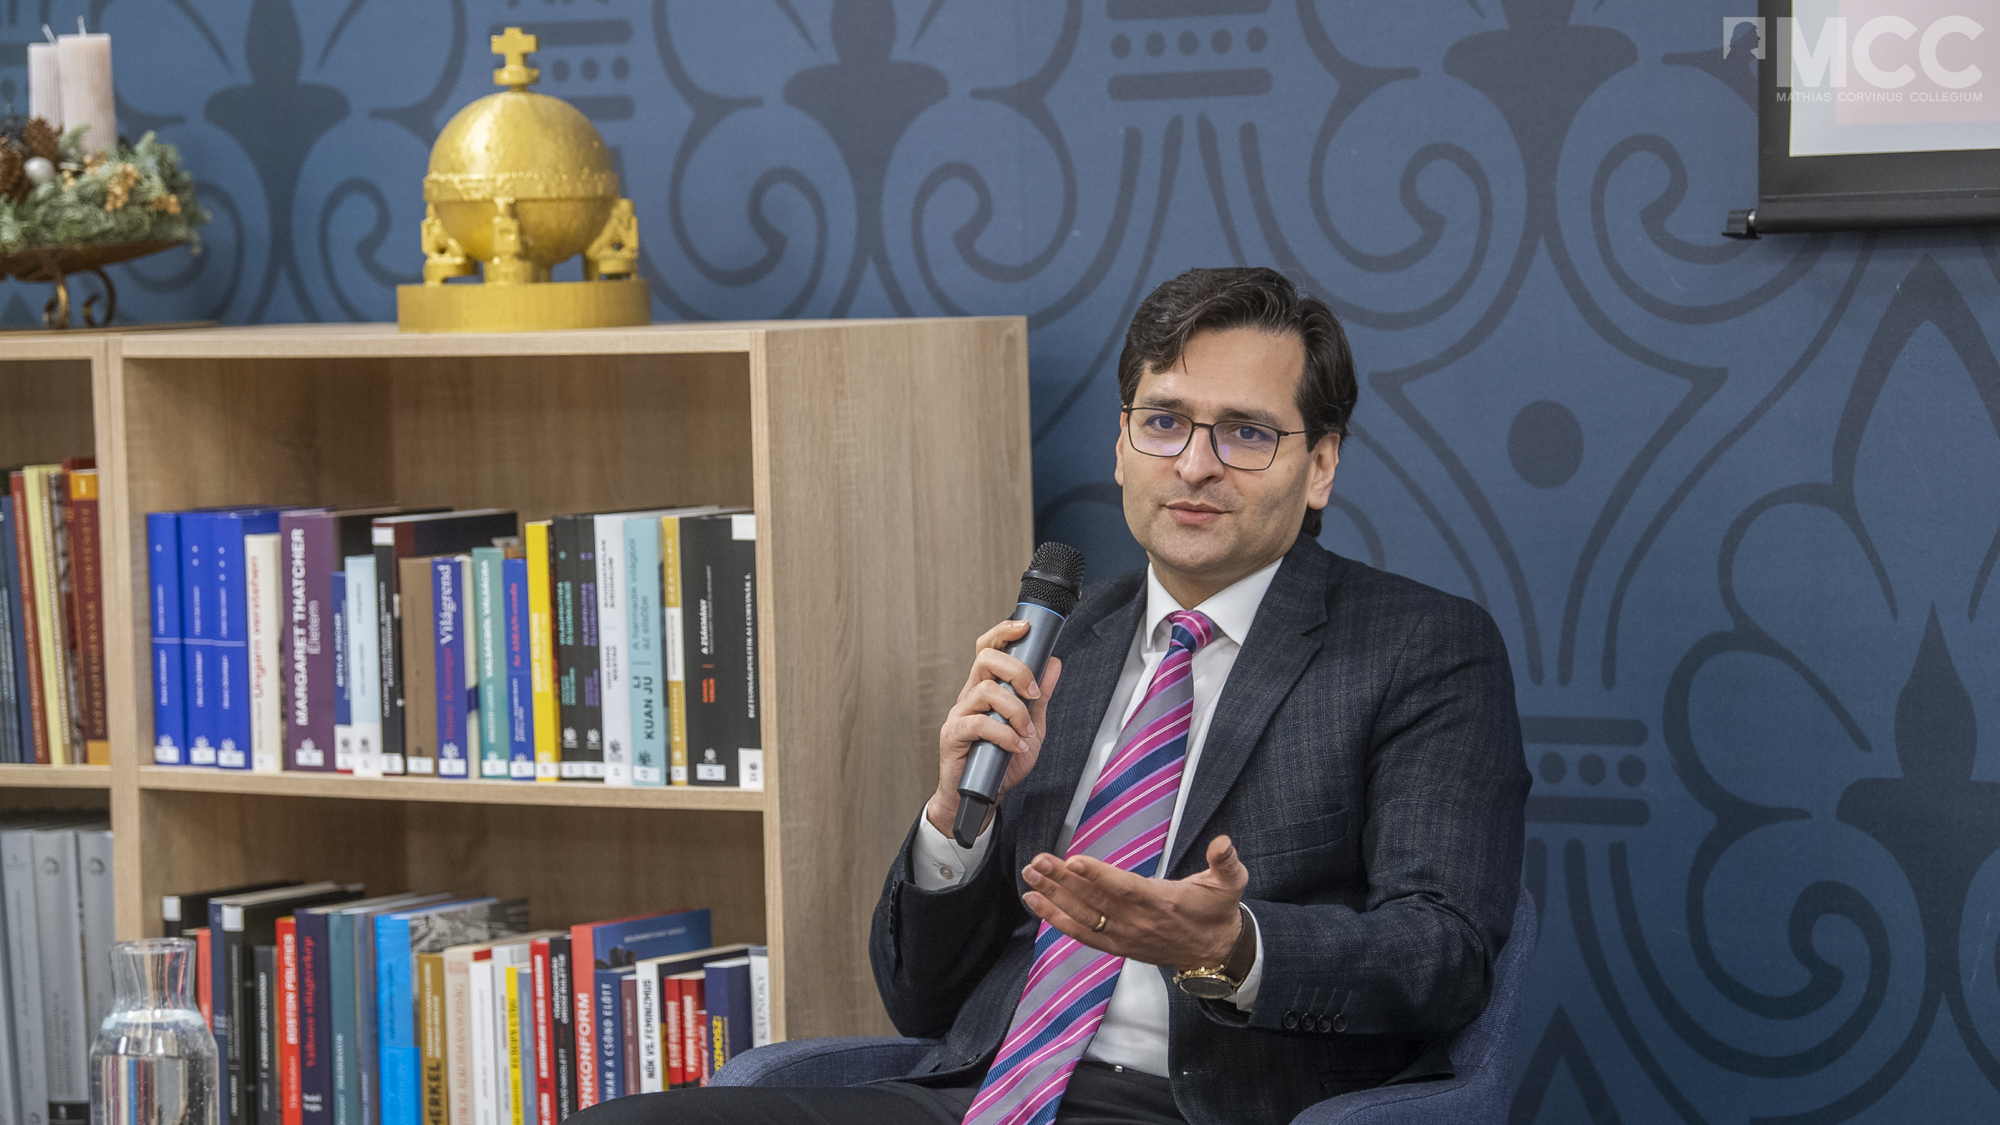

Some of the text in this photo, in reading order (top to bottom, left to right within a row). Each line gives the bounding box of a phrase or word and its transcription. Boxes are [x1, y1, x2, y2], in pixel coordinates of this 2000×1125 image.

[291, 528, 309, 726] MARGARET THATCHER
[437, 564, 457, 645] Világrend
[632, 675, 641, 689] LI
[642, 675, 654, 740] KUAN JU
[642, 978, 653, 1040] FEMINIZMUS
[577, 992, 595, 1109] ONKONFORM
[603, 1059, 615, 1068] A
